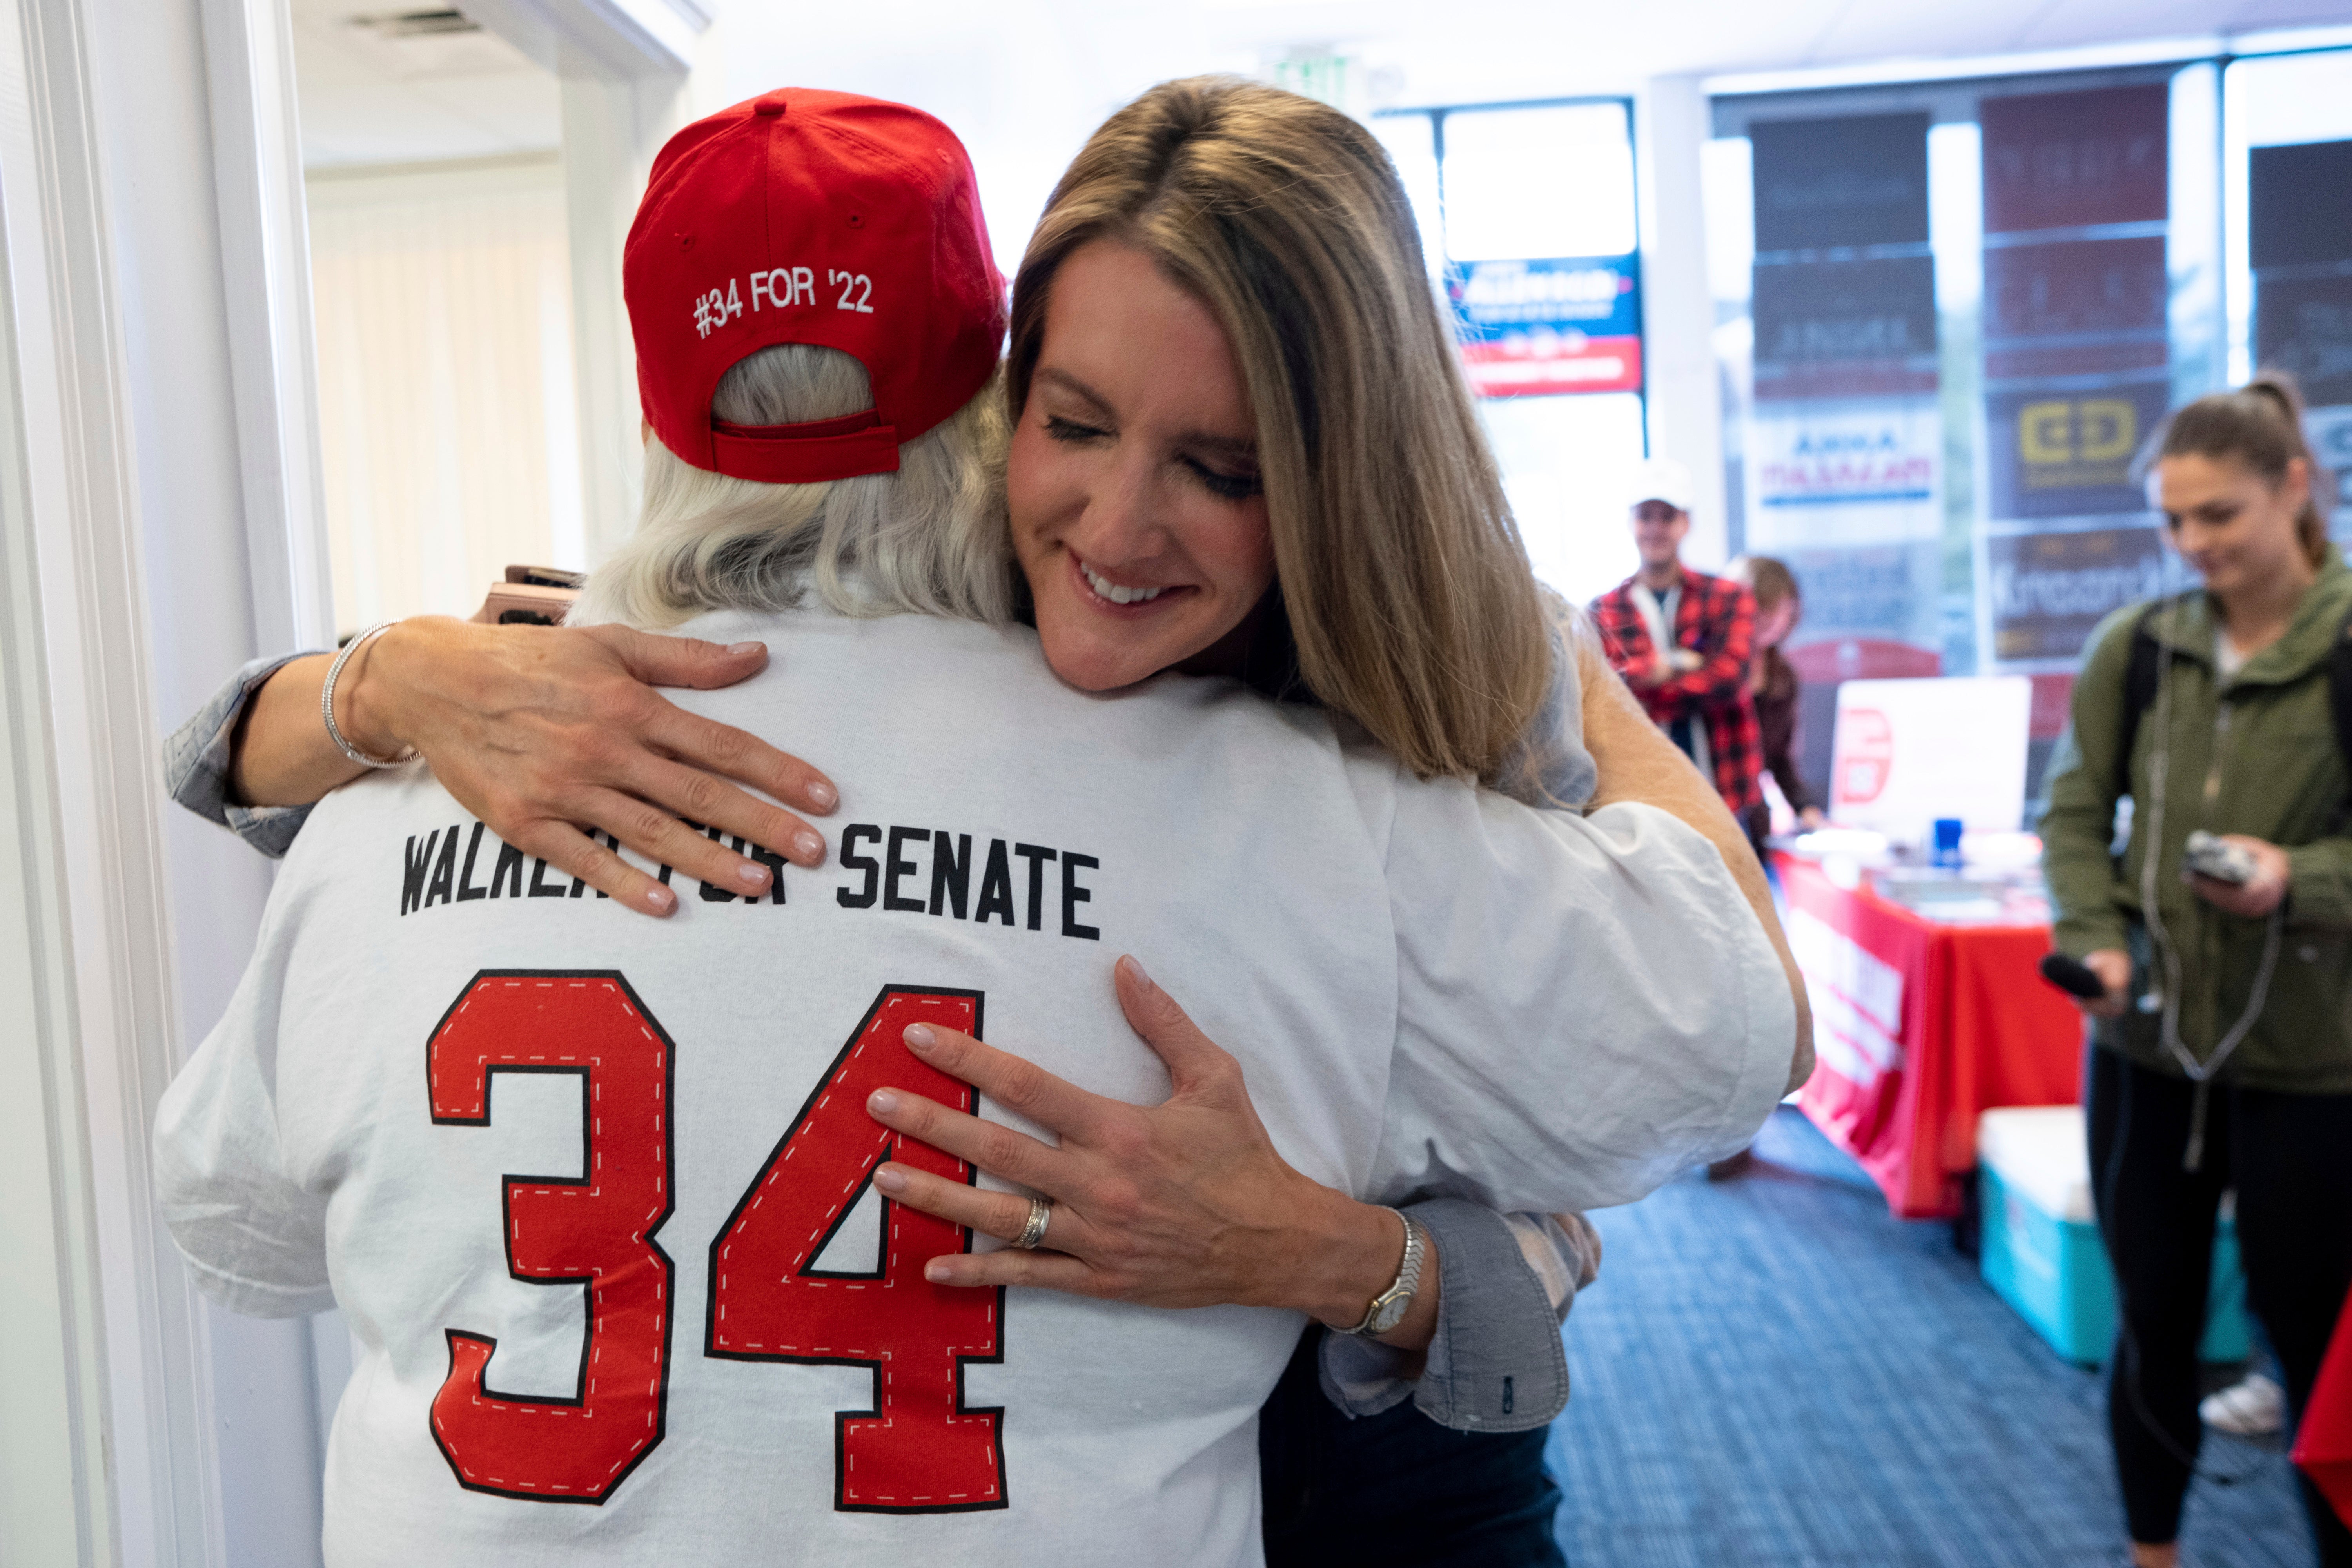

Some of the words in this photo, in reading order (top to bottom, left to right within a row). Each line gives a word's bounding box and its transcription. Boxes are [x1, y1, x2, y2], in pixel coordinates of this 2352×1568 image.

[693, 278, 743, 339] #34
[750, 266, 816, 312] FOR
[828, 269, 874, 314] '22
[401, 821, 619, 916] WALK
[836, 823, 1100, 941] SENATE
[426, 969, 1009, 1514] 34
